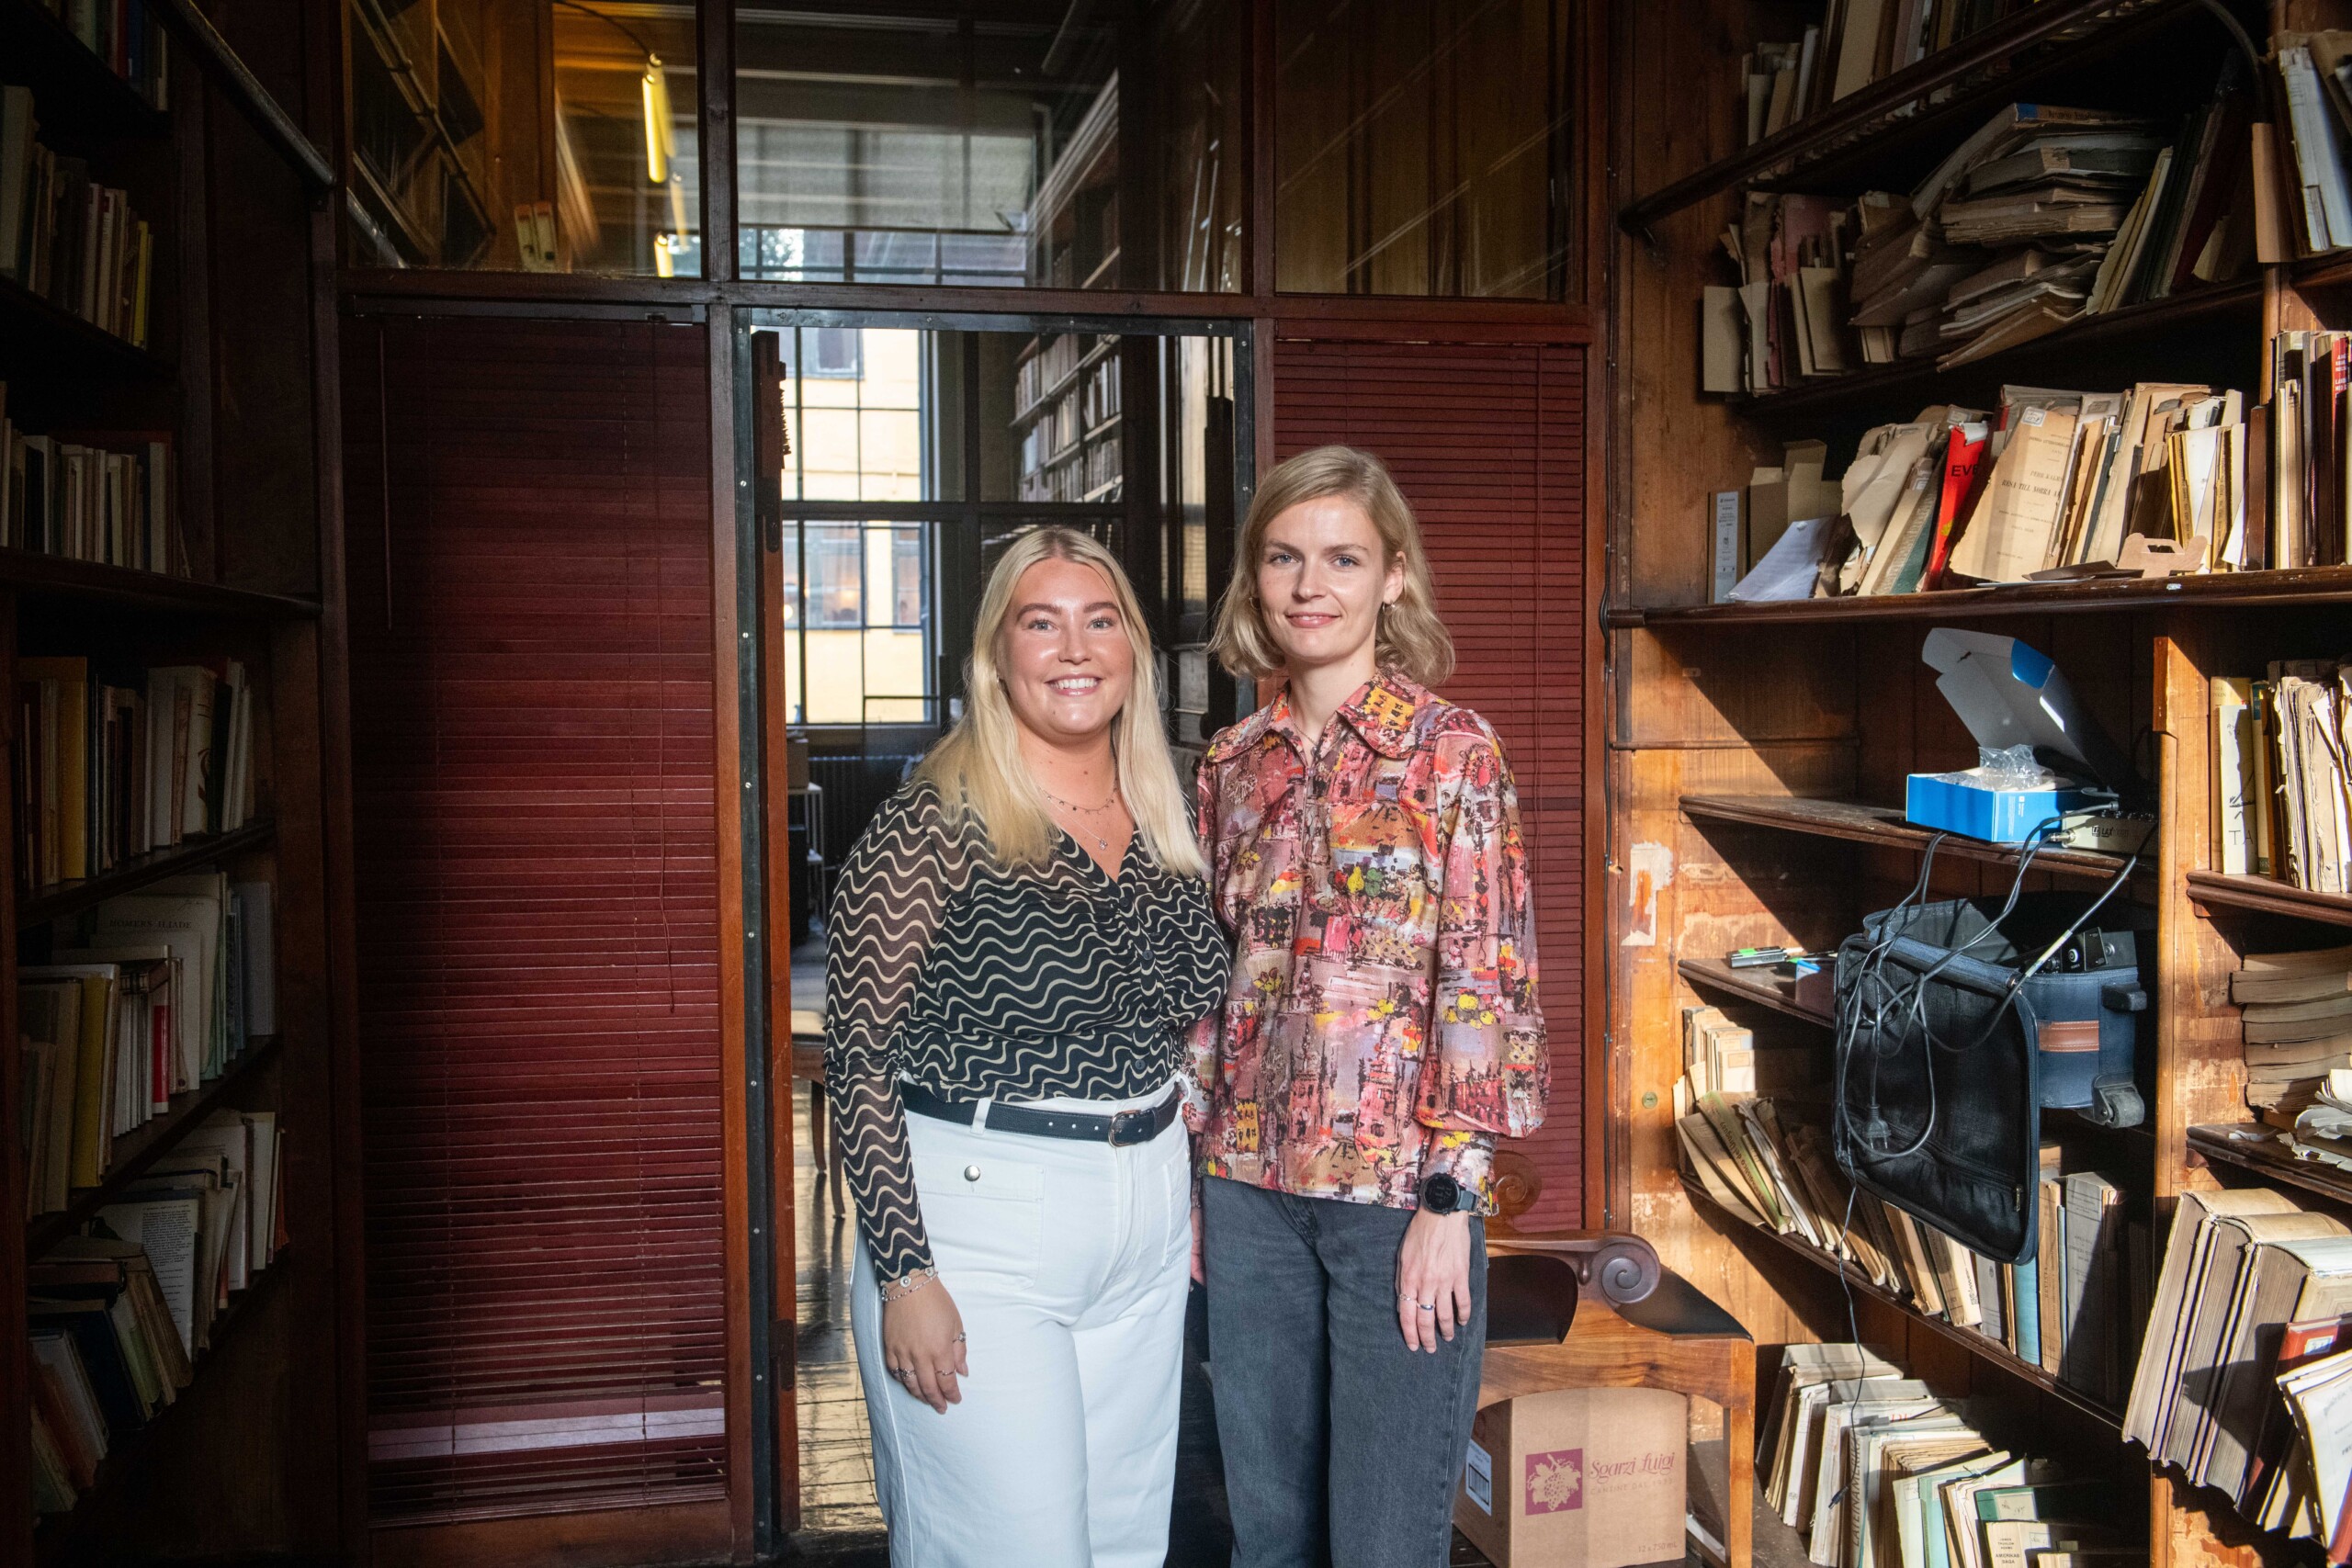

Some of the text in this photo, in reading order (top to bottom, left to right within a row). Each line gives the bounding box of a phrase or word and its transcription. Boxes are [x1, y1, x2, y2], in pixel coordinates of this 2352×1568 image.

[2018, 482, 2030, 491] TILL
[2032, 486, 2051, 496] NORRA
[1720, 1122, 1736, 1149] Uruguay
[1589, 1452, 1675, 1484] Sgarzi Luigi
[1654, 1542, 1666, 1551] 750
